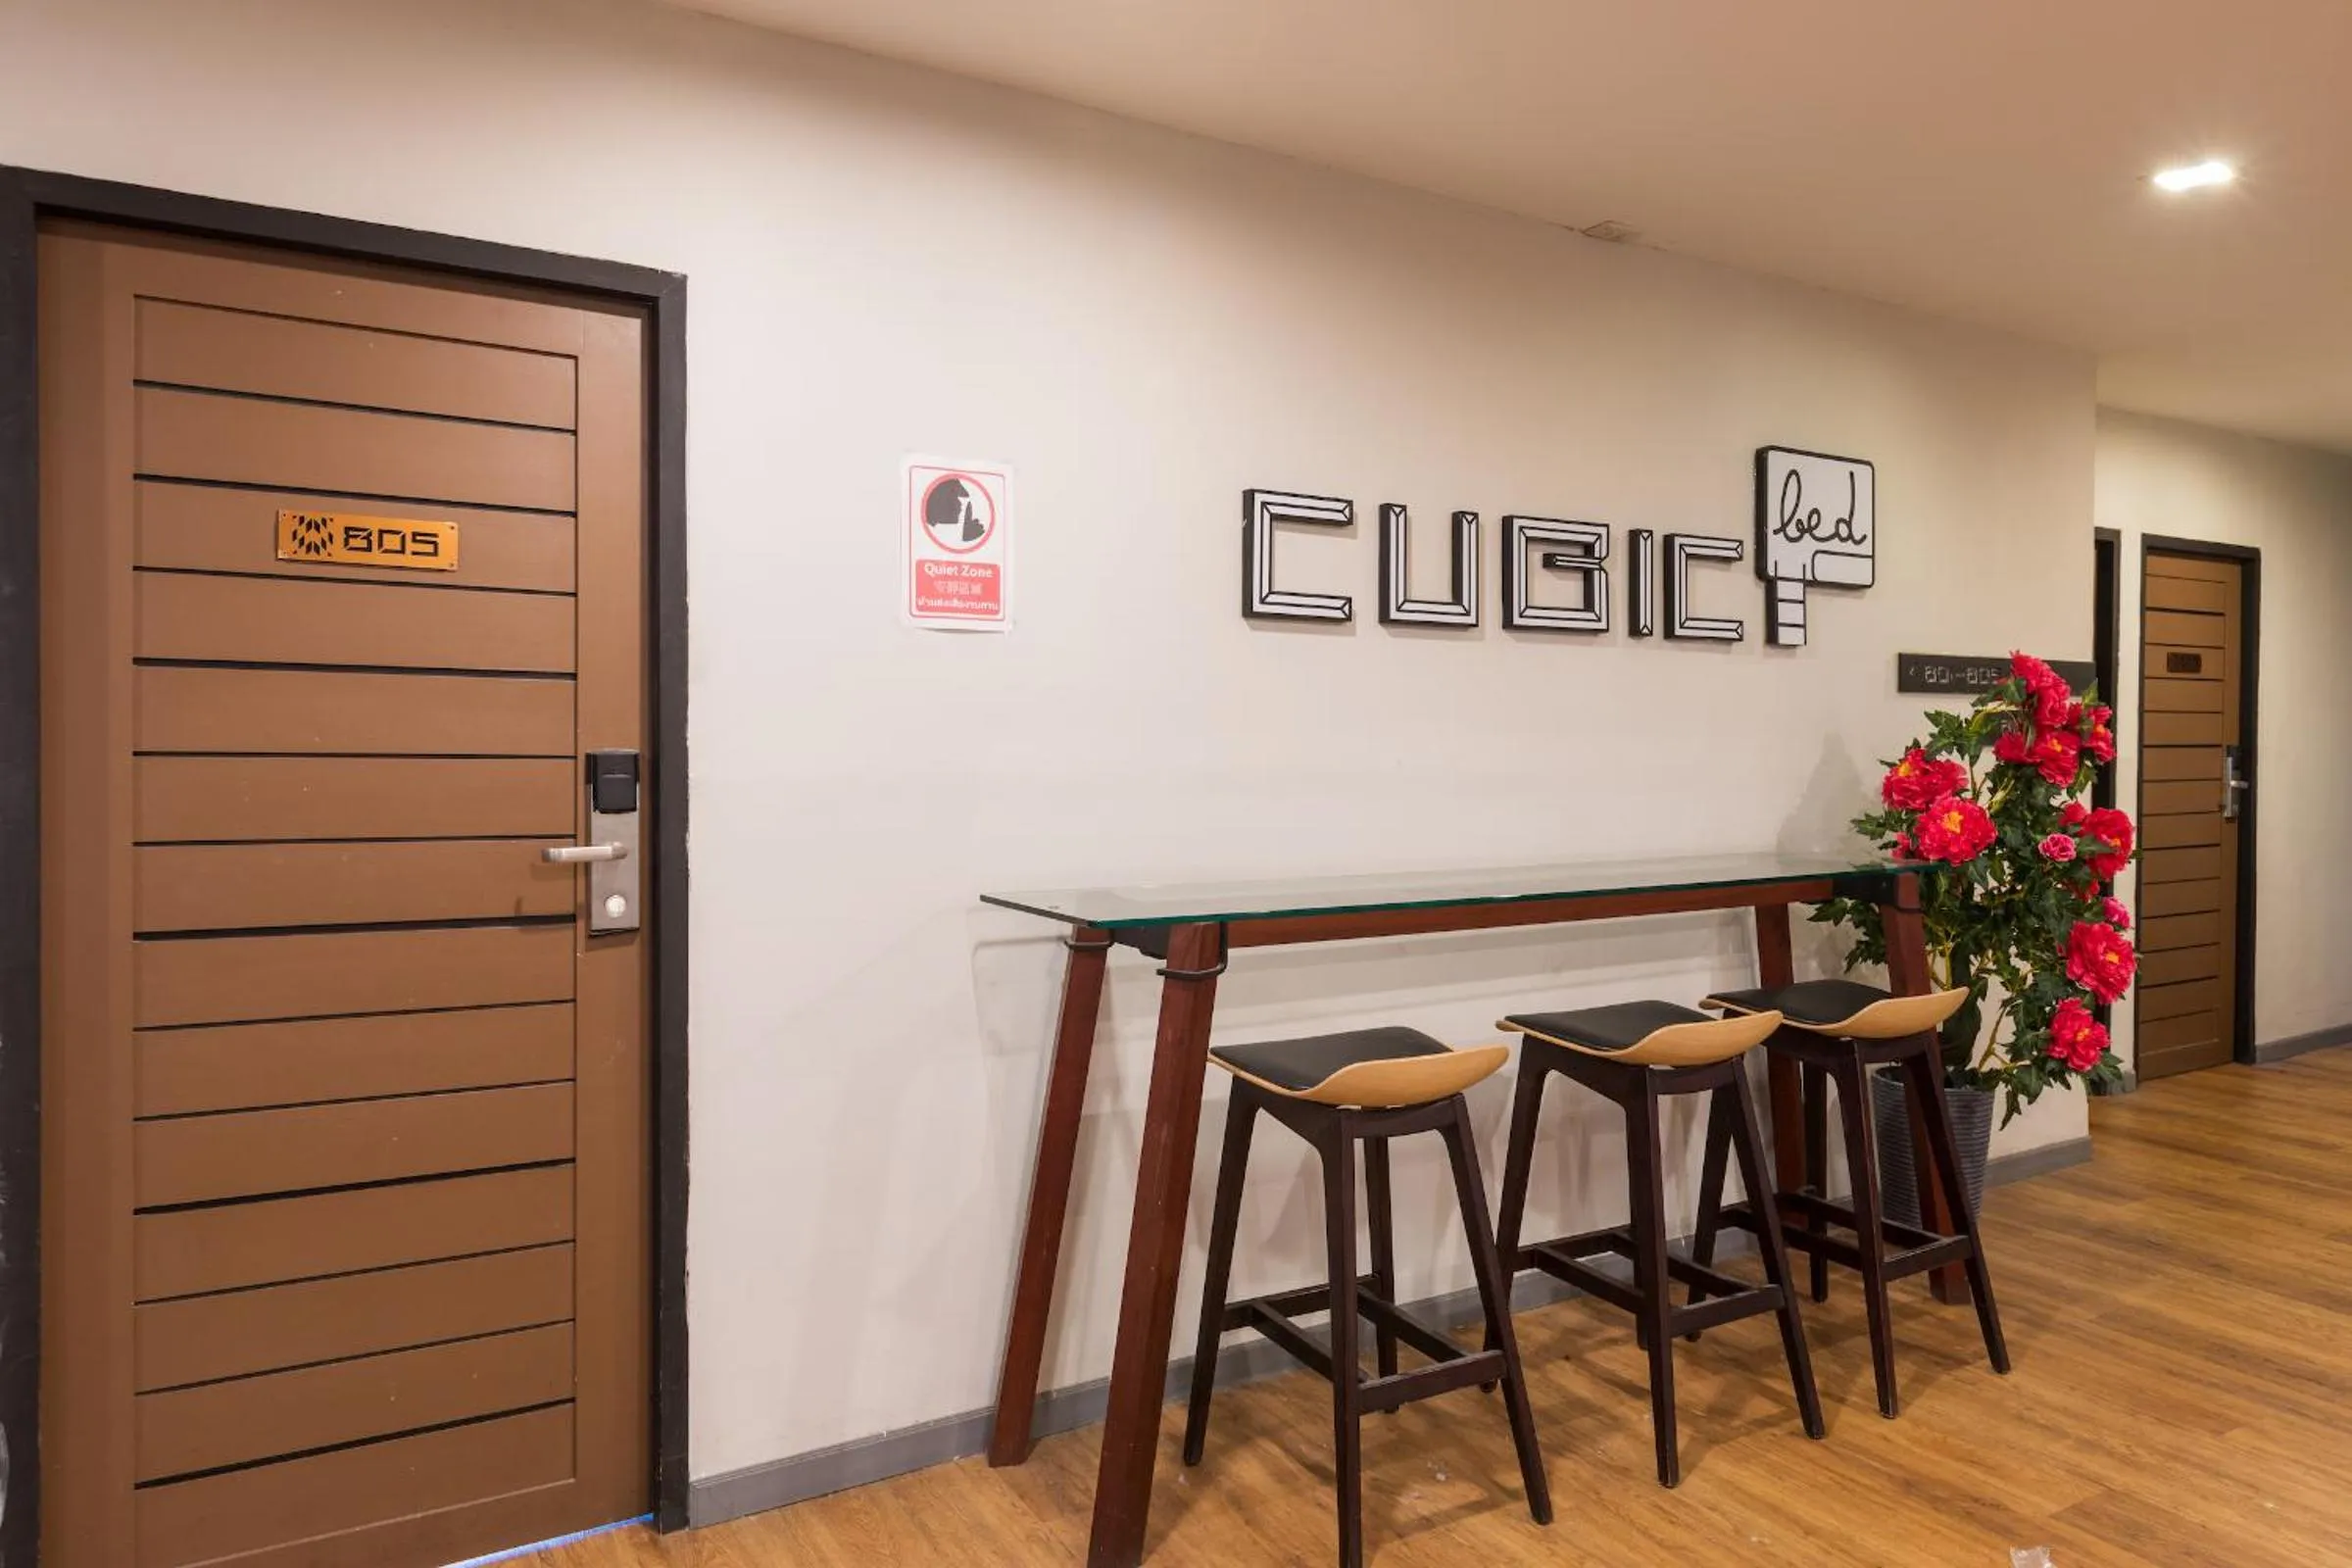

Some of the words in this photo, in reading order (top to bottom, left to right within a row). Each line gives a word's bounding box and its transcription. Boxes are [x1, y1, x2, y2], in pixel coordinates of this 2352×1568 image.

[344, 525, 440, 558] 805
[1243, 488, 1744, 643] CUBIC
[1773, 468, 1867, 545] bed
[924, 562, 958, 578] Quiet
[959, 564, 994, 578] Zone
